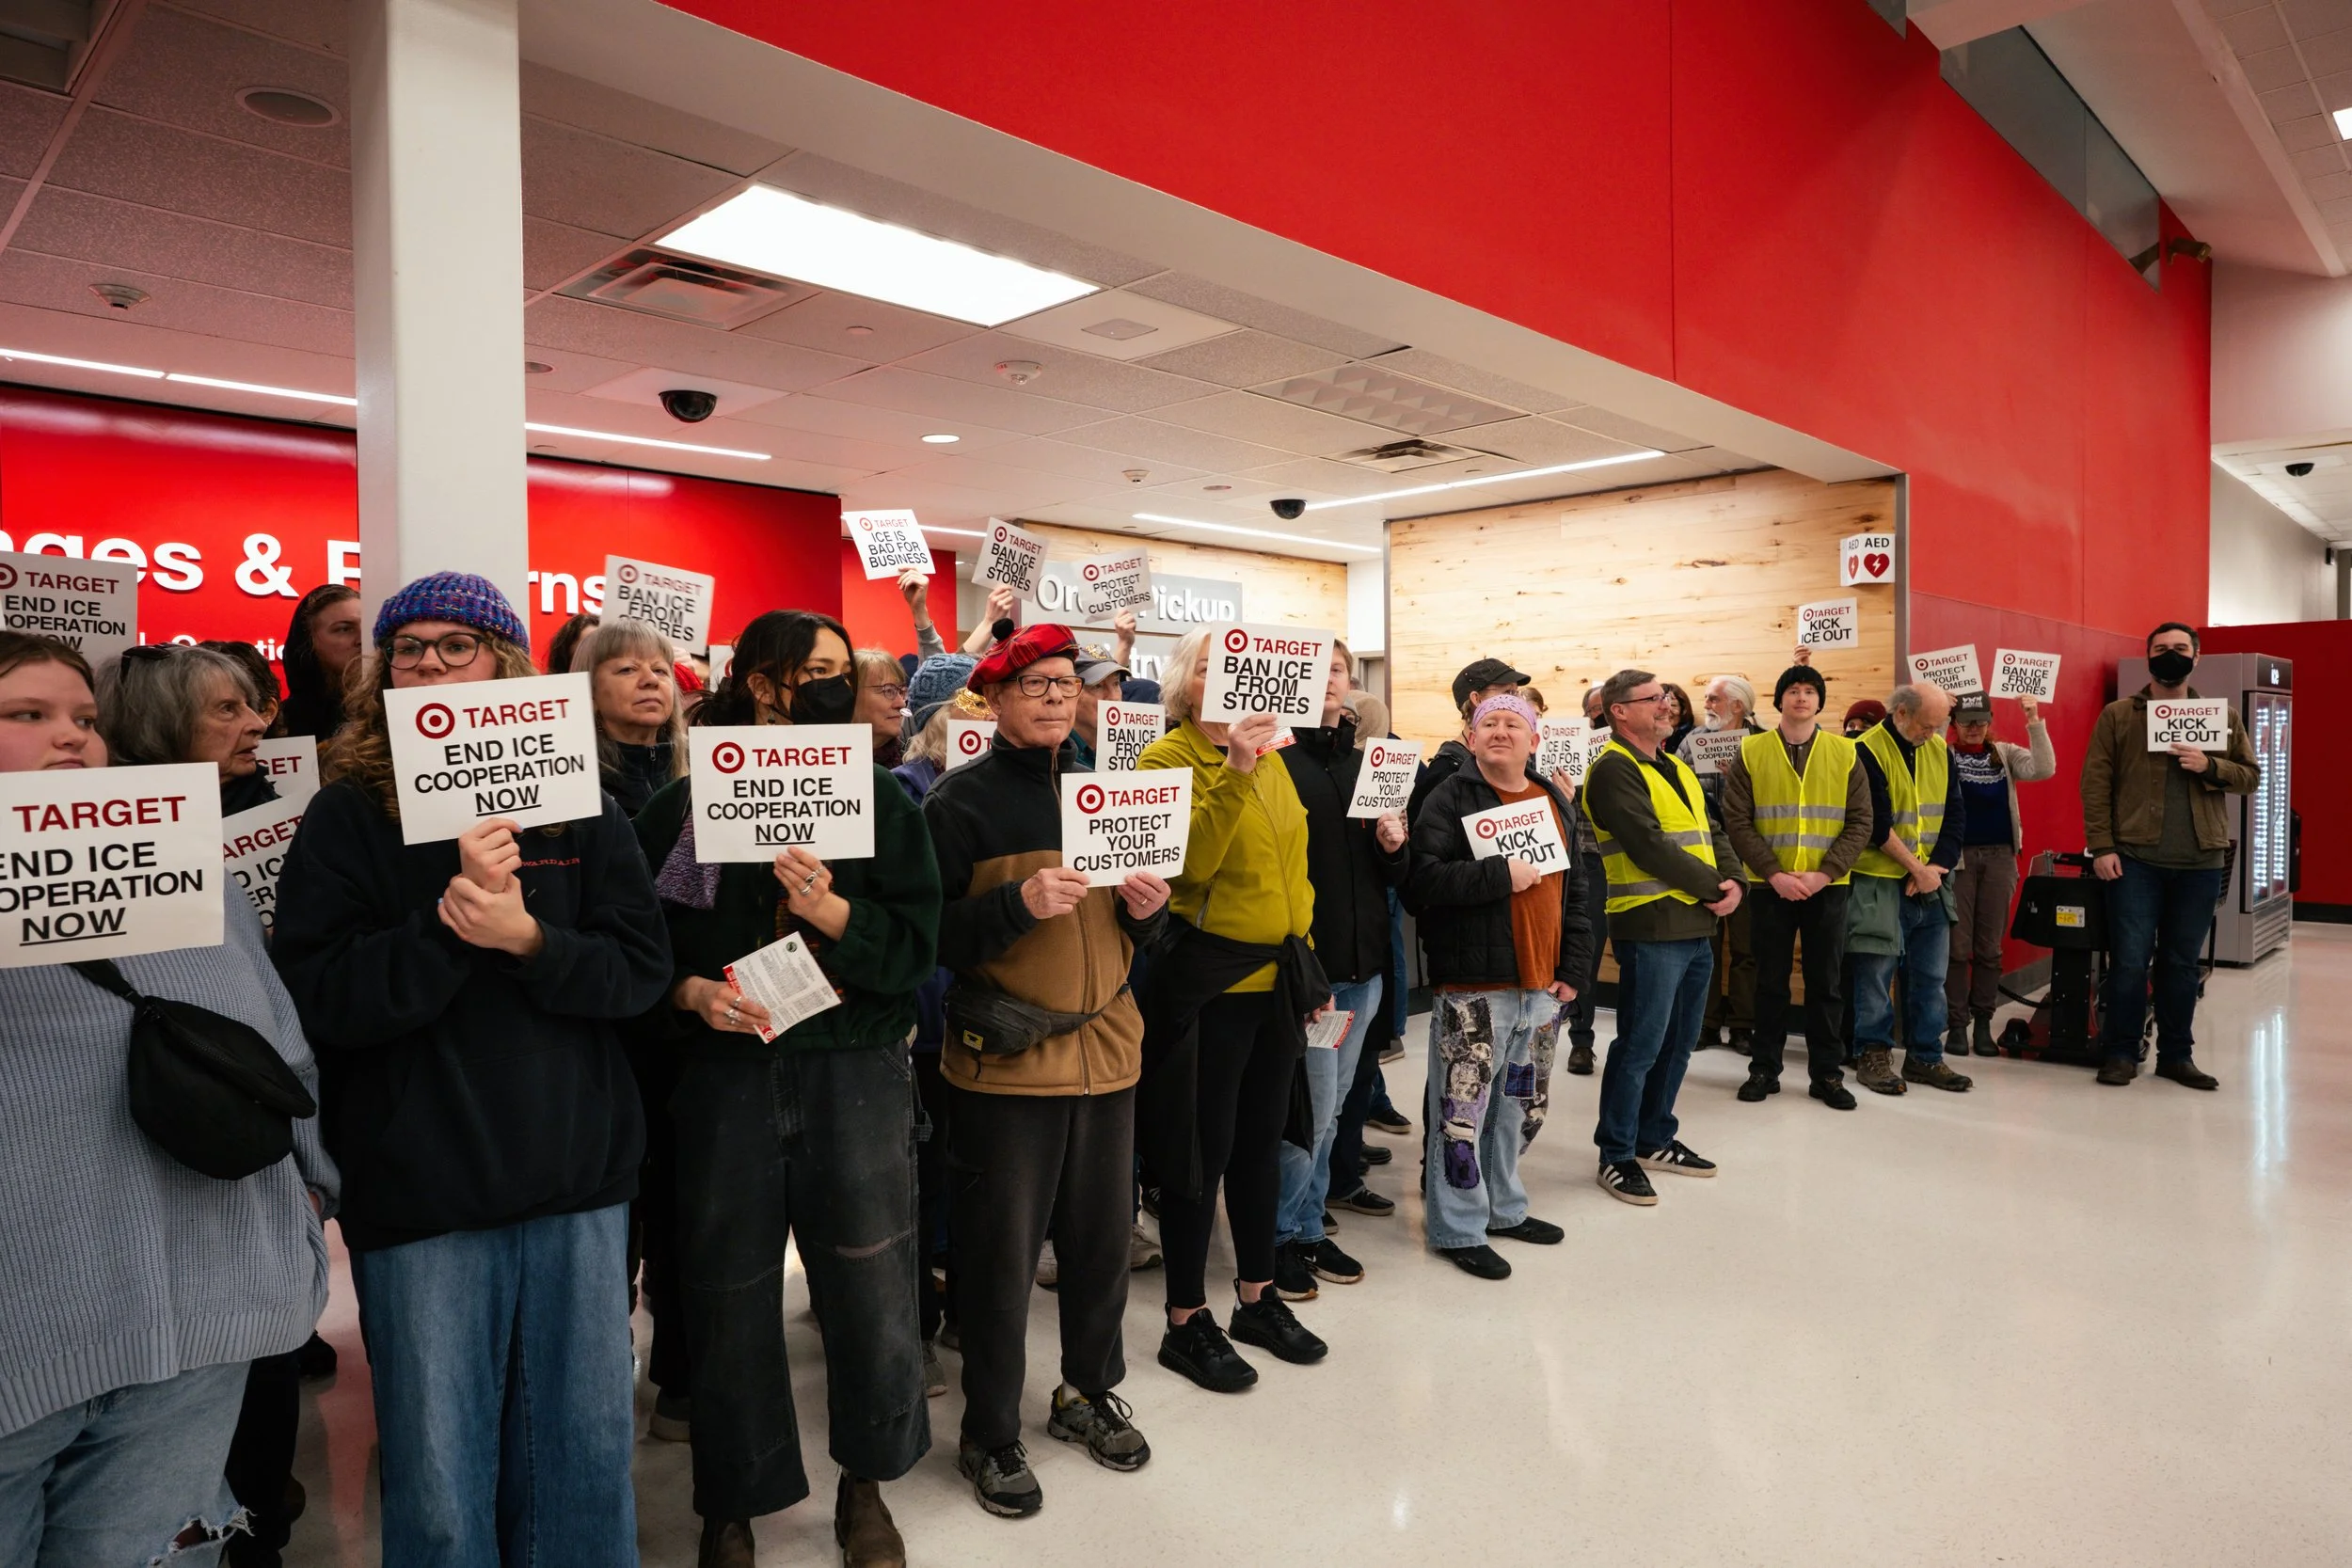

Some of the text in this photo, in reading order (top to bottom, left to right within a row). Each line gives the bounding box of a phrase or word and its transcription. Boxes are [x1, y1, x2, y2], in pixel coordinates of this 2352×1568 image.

[874, 518, 909, 529] TARGET
[871, 531, 906, 543] ICE IS
[1009, 534, 1043, 555] TARGET
[1849, 538, 1859, 551] AED
[1865, 537, 1890, 548] AED
[868, 541, 921, 556] BAD FOR
[991, 543, 1036, 570] BAN ICE
[235, 532, 299, 597] &
[869, 553, 929, 568] BUSINESS
[994, 558, 1027, 578] FROM
[1101, 557, 1142, 576] TARGET
[24, 571, 119, 594] TARGET
[644, 572, 704, 597] TARGET
[986, 567, 1032, 593] STORES
[1093, 573, 1140, 594] PROTECT
[617, 584, 696, 613] BAN ICE
[1105, 586, 1135, 599] YOUR
[6, 594, 102, 617] END ICE
[1088, 592, 1152, 614] CUSTOMERS
[1813, 606, 1851, 618] TARGET
[628, 601, 684, 626] FROM
[618, 614, 694, 642] RES
[1809, 617, 1840, 631] KICK
[1801, 628, 1851, 644] ICE OUT
[1253, 638, 1322, 657] TARGET
[1224, 656, 1312, 680] BAN ICE
[1930, 653, 1968, 668] TARGET
[2018, 657, 2055, 669] TARGET
[1922, 665, 1966, 679] PROTECT
[1932, 674, 1960, 685] YOUR
[2002, 666, 2049, 679] BAN ICE
[2008, 674, 2042, 687] FROM
[1234, 674, 1298, 696] FROM
[1939, 678, 1978, 691] OMERS
[2001, 683, 2047, 696] STORES
[1222, 691, 1310, 715] STORES
[2171, 706, 2220, 716] TARGET
[462, 699, 570, 729] TARGET
[1122, 713, 1159, 726] TARGET
[1551, 727, 1581, 736] TARGET
[2167, 718, 2207, 730] KICK
[1107, 728, 1156, 743] BAN ICE
[2154, 730, 2220, 743] ICE OUT
[444, 734, 556, 766] END ICE
[1546, 740, 1570, 752] ICE IS
[752, 746, 851, 768] TARGET
[1386, 752, 1417, 766] TARGET
[1541, 753, 1557, 766] BAD
[1559, 752, 1581, 764] FOR
[414, 754, 585, 794] COOPERATION
[1372, 771, 1409, 784] PROTECT
[734, 777, 834, 799] END ICE
[1108, 786, 1180, 807] TARGET
[1379, 784, 1401, 796] YOUR
[475, 784, 540, 815] NOW
[1357, 796, 1406, 809] CUSTOMERS
[12, 796, 186, 832] TARGET
[707, 799, 861, 820] COOPERATION
[1089, 814, 1171, 835] PROTECT
[1495, 810, 1545, 832] TARGET
[755, 822, 815, 843] NOW
[1106, 833, 1156, 851] YOUR
[1495, 828, 1539, 853] KICK
[88, 841, 157, 872] ICE
[1073, 847, 1181, 872] CUSTOMERS
[1519, 842, 1555, 864] OUT
[22, 907, 127, 943] NOW
